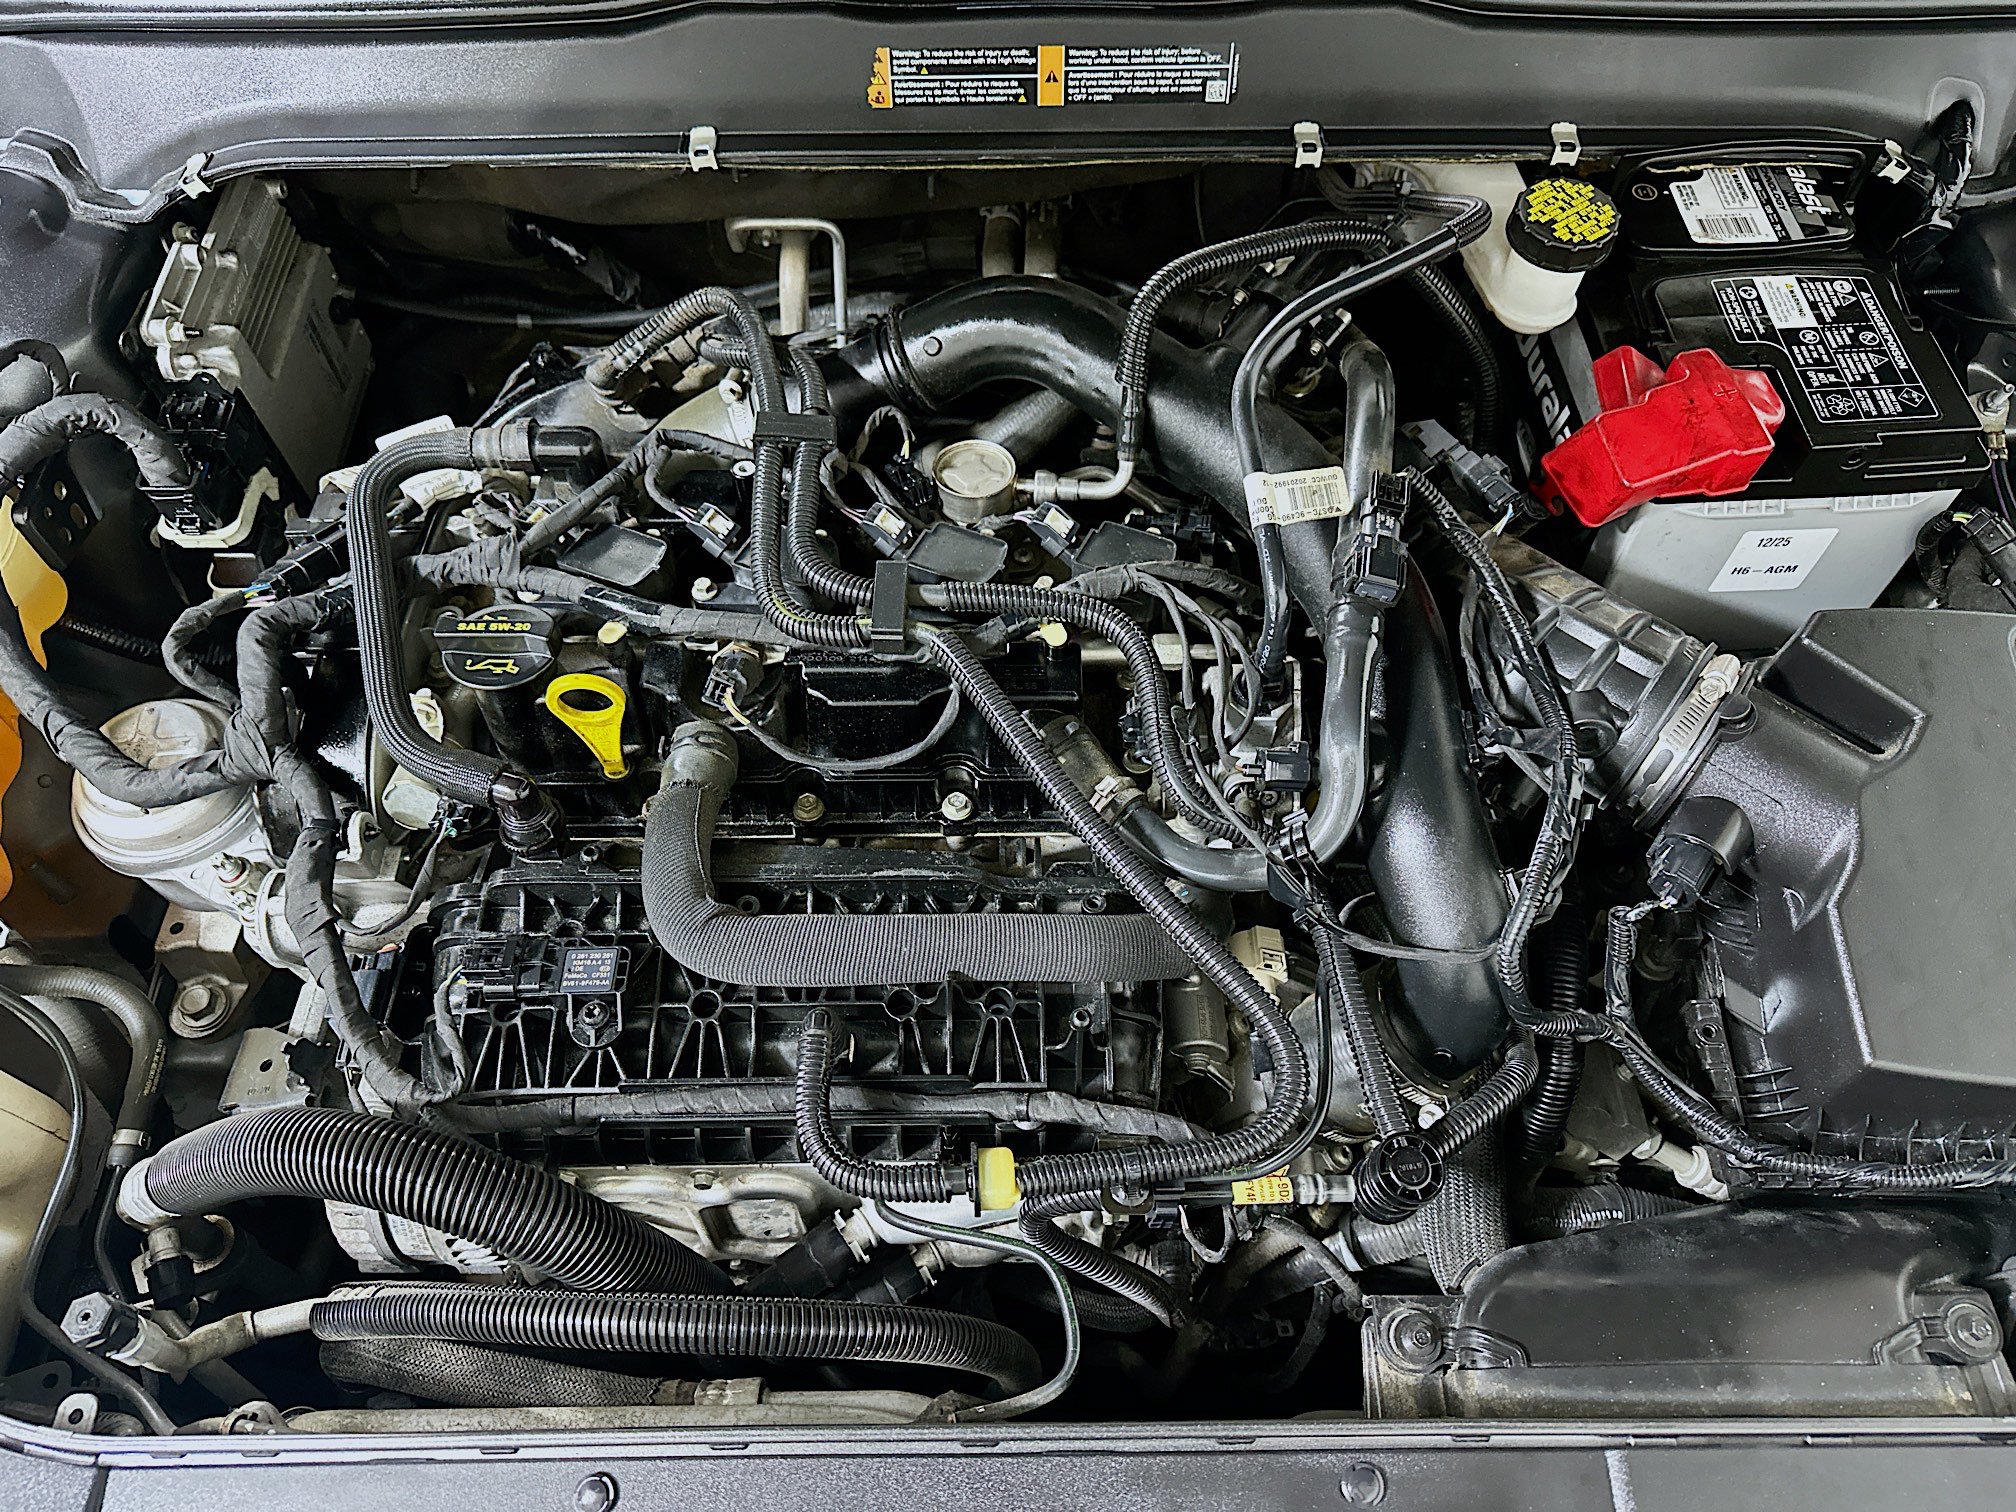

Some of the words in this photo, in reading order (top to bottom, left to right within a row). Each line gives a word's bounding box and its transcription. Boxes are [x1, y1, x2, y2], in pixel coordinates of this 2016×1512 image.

[1786, 166, 1832, 215] alast
[1864, 298, 1909, 369] DANGER/POISON
[1757, 537, 1793, 547] 12/25
[1731, 567, 1751, 575] H6
[1764, 565, 1799, 574] AGM
[457, 623, 486, 631] SAE
[488, 623, 531, 631] 5W-20
